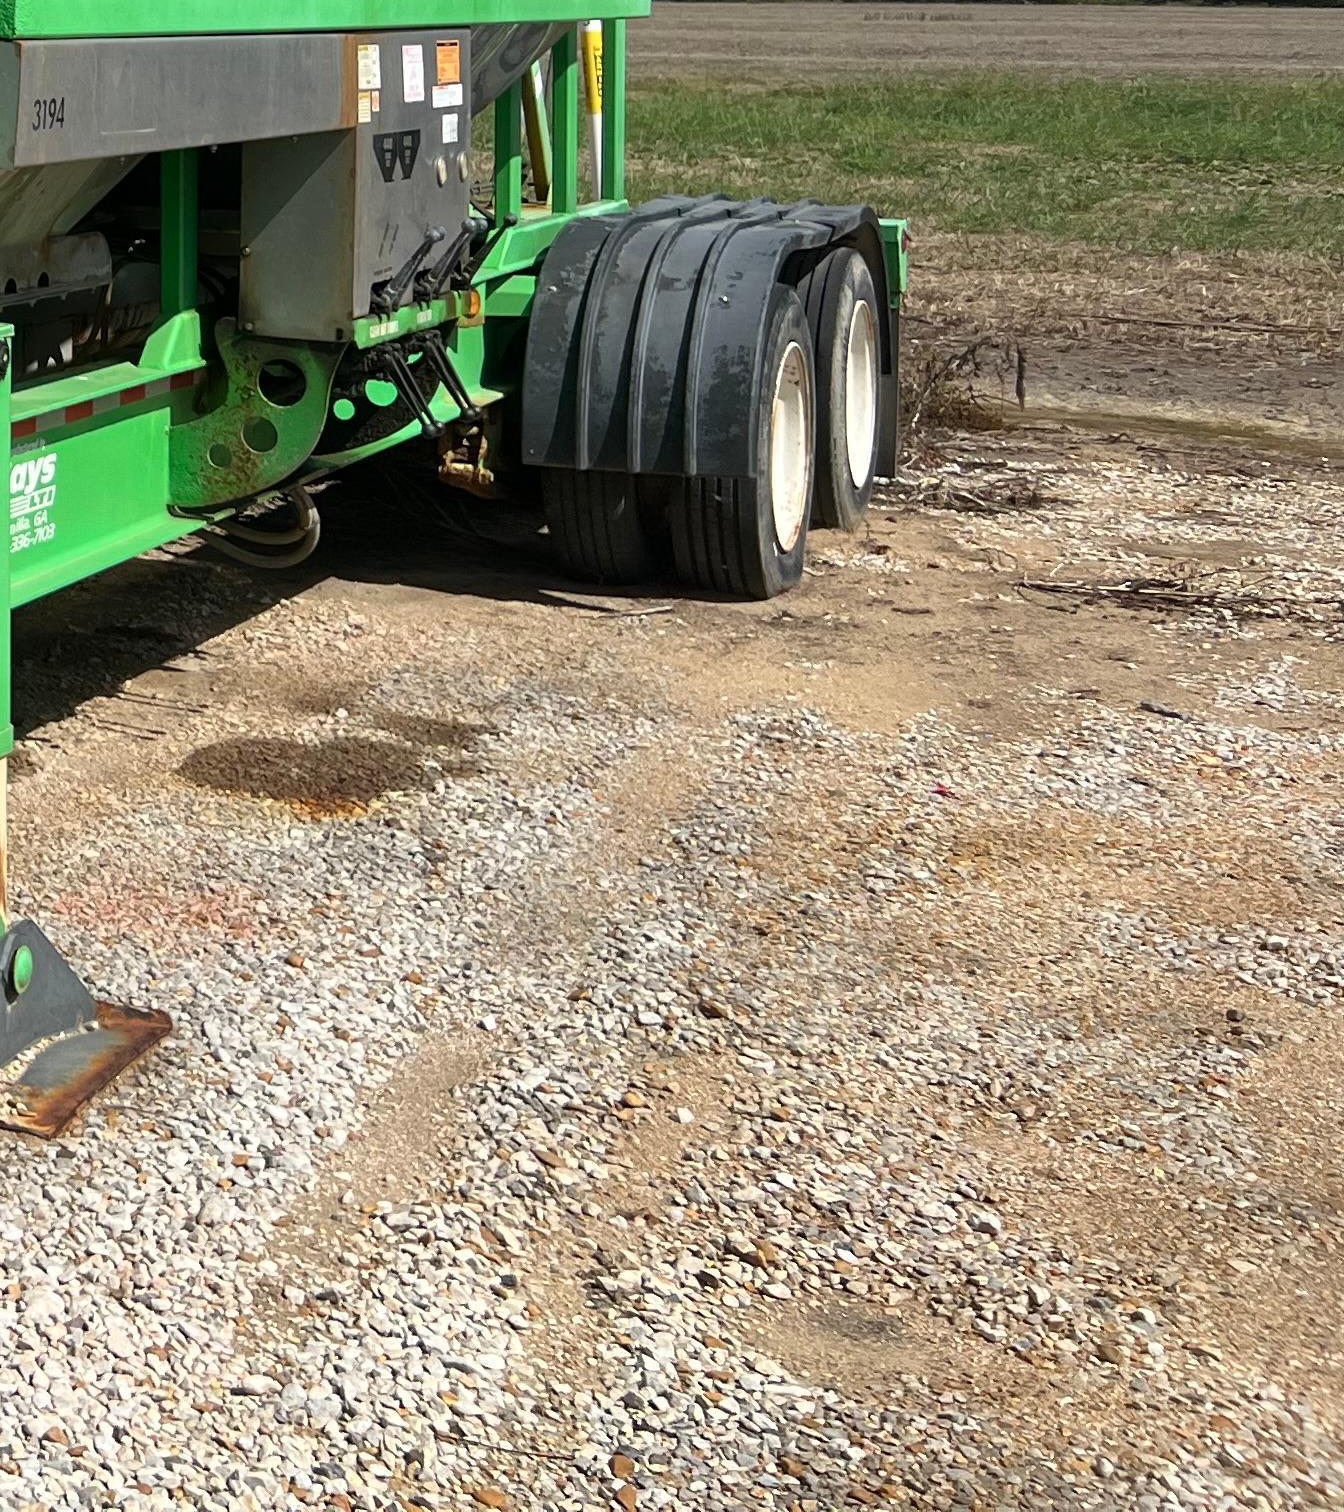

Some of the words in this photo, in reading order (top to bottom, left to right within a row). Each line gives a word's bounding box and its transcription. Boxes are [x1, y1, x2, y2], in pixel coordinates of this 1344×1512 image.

[32, 97, 65, 131] 3194
[9, 452, 58, 495] ays
[33, 509, 48, 527] GA
